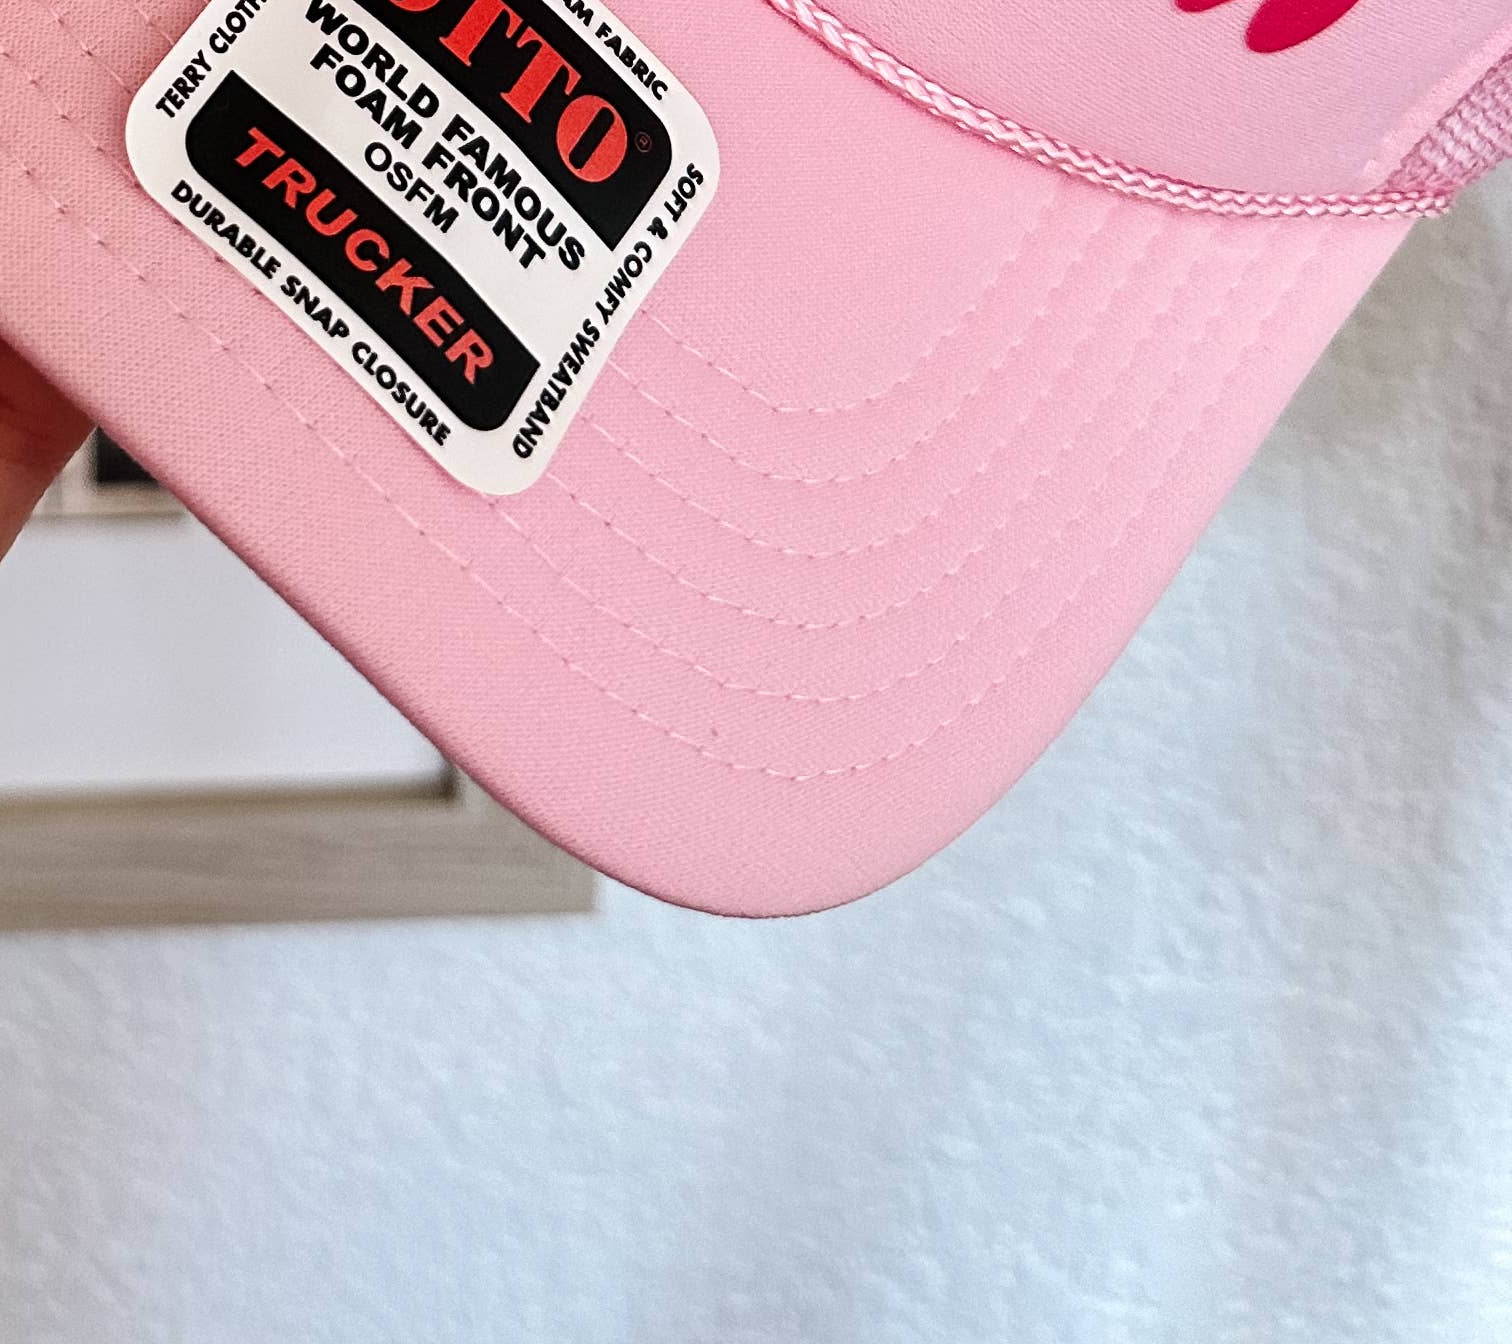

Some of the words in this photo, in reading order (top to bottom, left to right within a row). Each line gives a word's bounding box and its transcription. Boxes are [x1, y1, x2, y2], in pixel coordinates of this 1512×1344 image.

[155, 50, 210, 119] TERRY
[595, 21, 668, 101] FABRIC
[309, 44, 423, 150] FOAM
[422, 141, 547, 270] FRONT
[364, 141, 461, 234] OSFM
[447, 117, 586, 272] FAMOUS
[662, 162, 705, 224] SOFT
[234, 126, 495, 385] TRUCKER
[654, 223, 670, 242] &
[171, 180, 281, 279] DURABLE
[281, 274, 352, 341] SNAP
[351, 338, 452, 447] CLOSURE
[599, 241, 653, 327] COMFY
[513, 318, 601, 460] SWEATBAND
